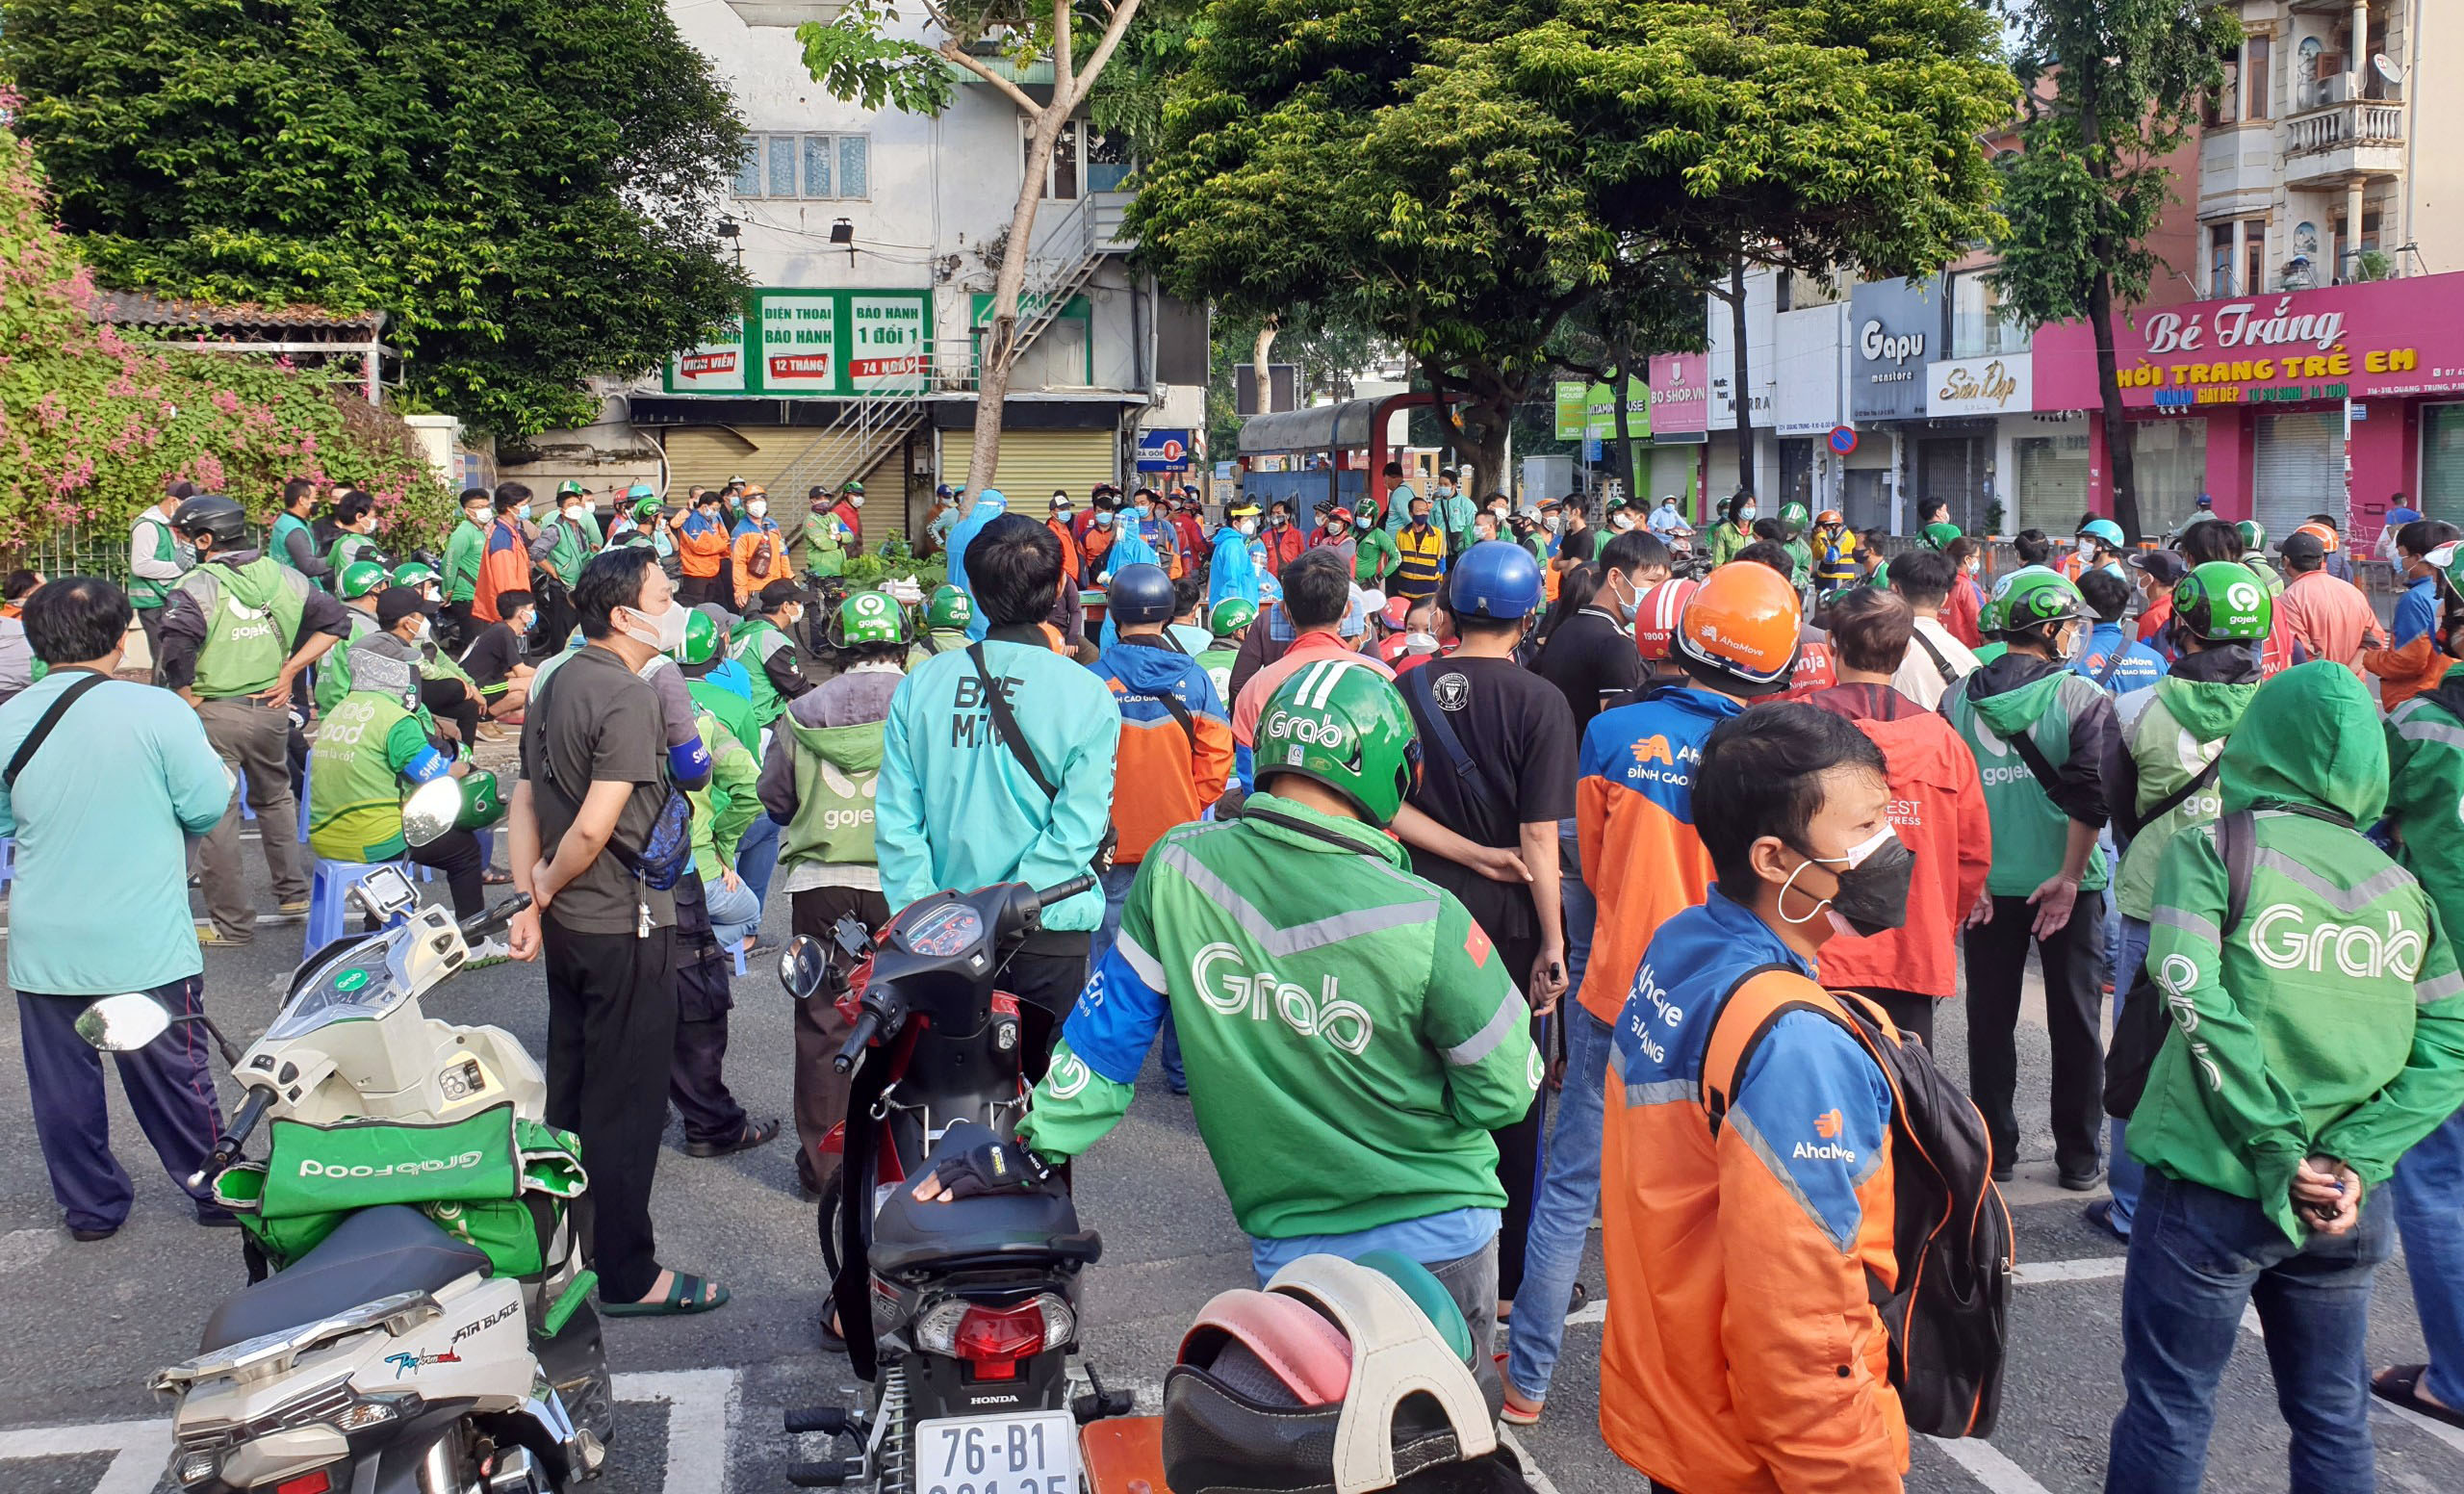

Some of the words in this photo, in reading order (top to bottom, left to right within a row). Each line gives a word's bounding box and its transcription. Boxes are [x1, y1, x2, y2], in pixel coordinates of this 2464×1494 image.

[764, 308, 792, 322] ĐIỆN
[796, 308, 832, 322] THOẠI
[857, 305, 881, 319] BẢO
[886, 305, 918, 320] HÀNH
[2145, 312, 2204, 353] Bé
[2215, 296, 2348, 350] Trắng
[764, 326, 792, 344] BẢO
[796, 328, 833, 344] HÀNH
[859, 327, 866, 344] 1
[1861, 320, 1924, 366] Gapu
[775, 361, 786, 371] 12
[789, 359, 824, 372] THÁNG
[2117, 357, 2165, 388] HỜI
[2170, 358, 2276, 385] TRANG
[2281, 344, 2351, 379] TRẺ
[2365, 348, 2418, 374] EM
[1871, 371, 1913, 384] menstore
[1651, 391, 1663, 404] BO
[1666, 387, 1706, 402] SHOP.VN
[1728, 396, 1770, 412] MRRA
[1627, 399, 1645, 412] USE
[950, 610, 971, 620] Grab
[1226, 612, 1247, 628] Grab
[2229, 615, 2258, 624] gojek
[1643, 631, 1664, 641] 1900
[1719, 635, 1764, 657] AhaMove
[1124, 695, 1142, 704] CAO
[1268, 710, 1343, 748] Grab
[1627, 764, 1659, 782] ĐỈNH
[1661, 772, 1688, 786] CAO
[1886, 800, 1922, 815] EST
[824, 809, 874, 830] goje
[2248, 903, 2423, 983] Grab
[1192, 941, 1373, 1056] Grab
[298, 1150, 483, 1178] GrabFood
[970, 1395, 1019, 1405] HONDA
[941, 1422, 1046, 1478] 76-B1
